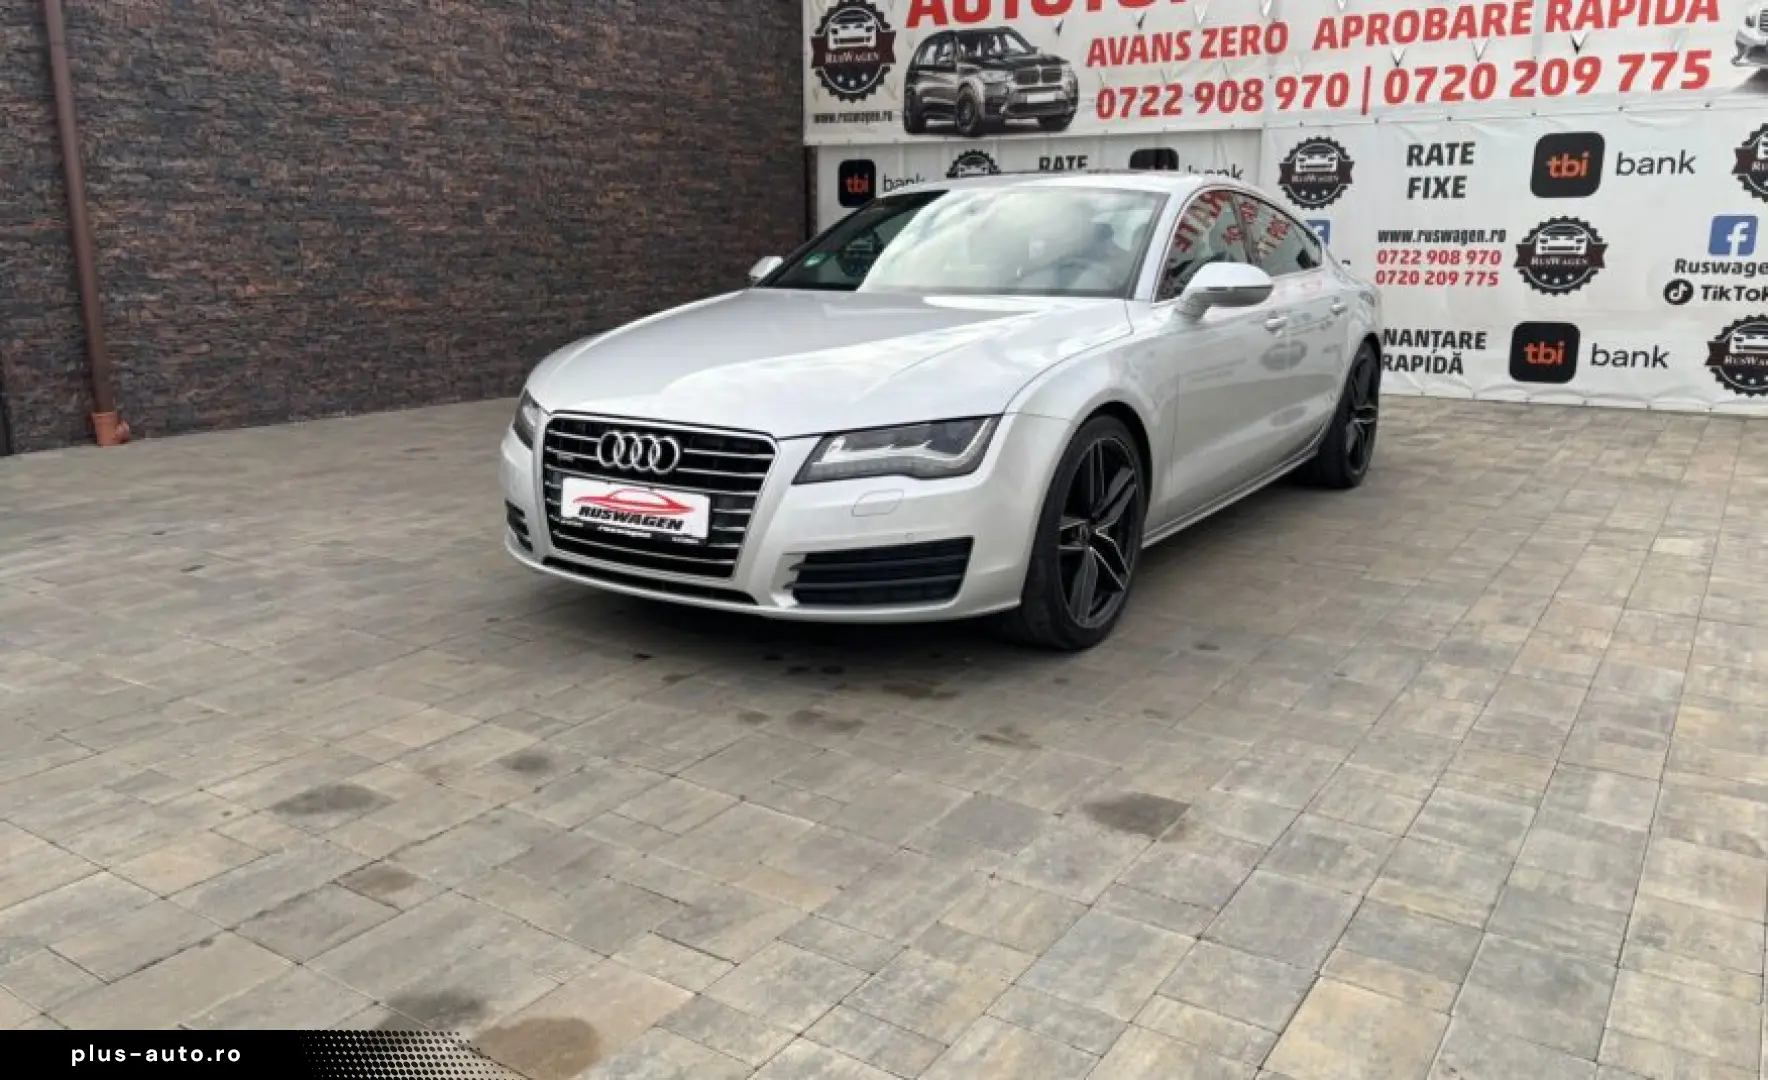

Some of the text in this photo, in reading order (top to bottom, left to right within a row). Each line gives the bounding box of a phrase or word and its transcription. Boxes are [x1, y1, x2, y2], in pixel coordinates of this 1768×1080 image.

[1312, 1, 1534, 50] APROBARE
[1086, 21, 1289, 67] AVANS ZERO
[1096, 83, 1184, 120] 0722
[1194, 78, 1264, 115] 908
[1275, 72, 1349, 109] 970
[1384, 62, 1496, 105] 0720
[1509, 55, 1602, 97] 209
[1618, 50, 1712, 93] 775
[1406, 141, 1476, 167] RATE
[1547, 149, 1696, 178] tbi bank
[845, 172, 870, 193] tbi
[1407, 175, 1467, 199] FIXE
[1378, 229, 1506, 245] www.ruswagen.ro
[1377, 249, 1502, 265] 0722 908 970
[1376, 270, 1499, 287] 0720 209 775
[1524, 341, 1669, 369] tbi bank
[578, 506, 685, 531] RUSWAGEN
